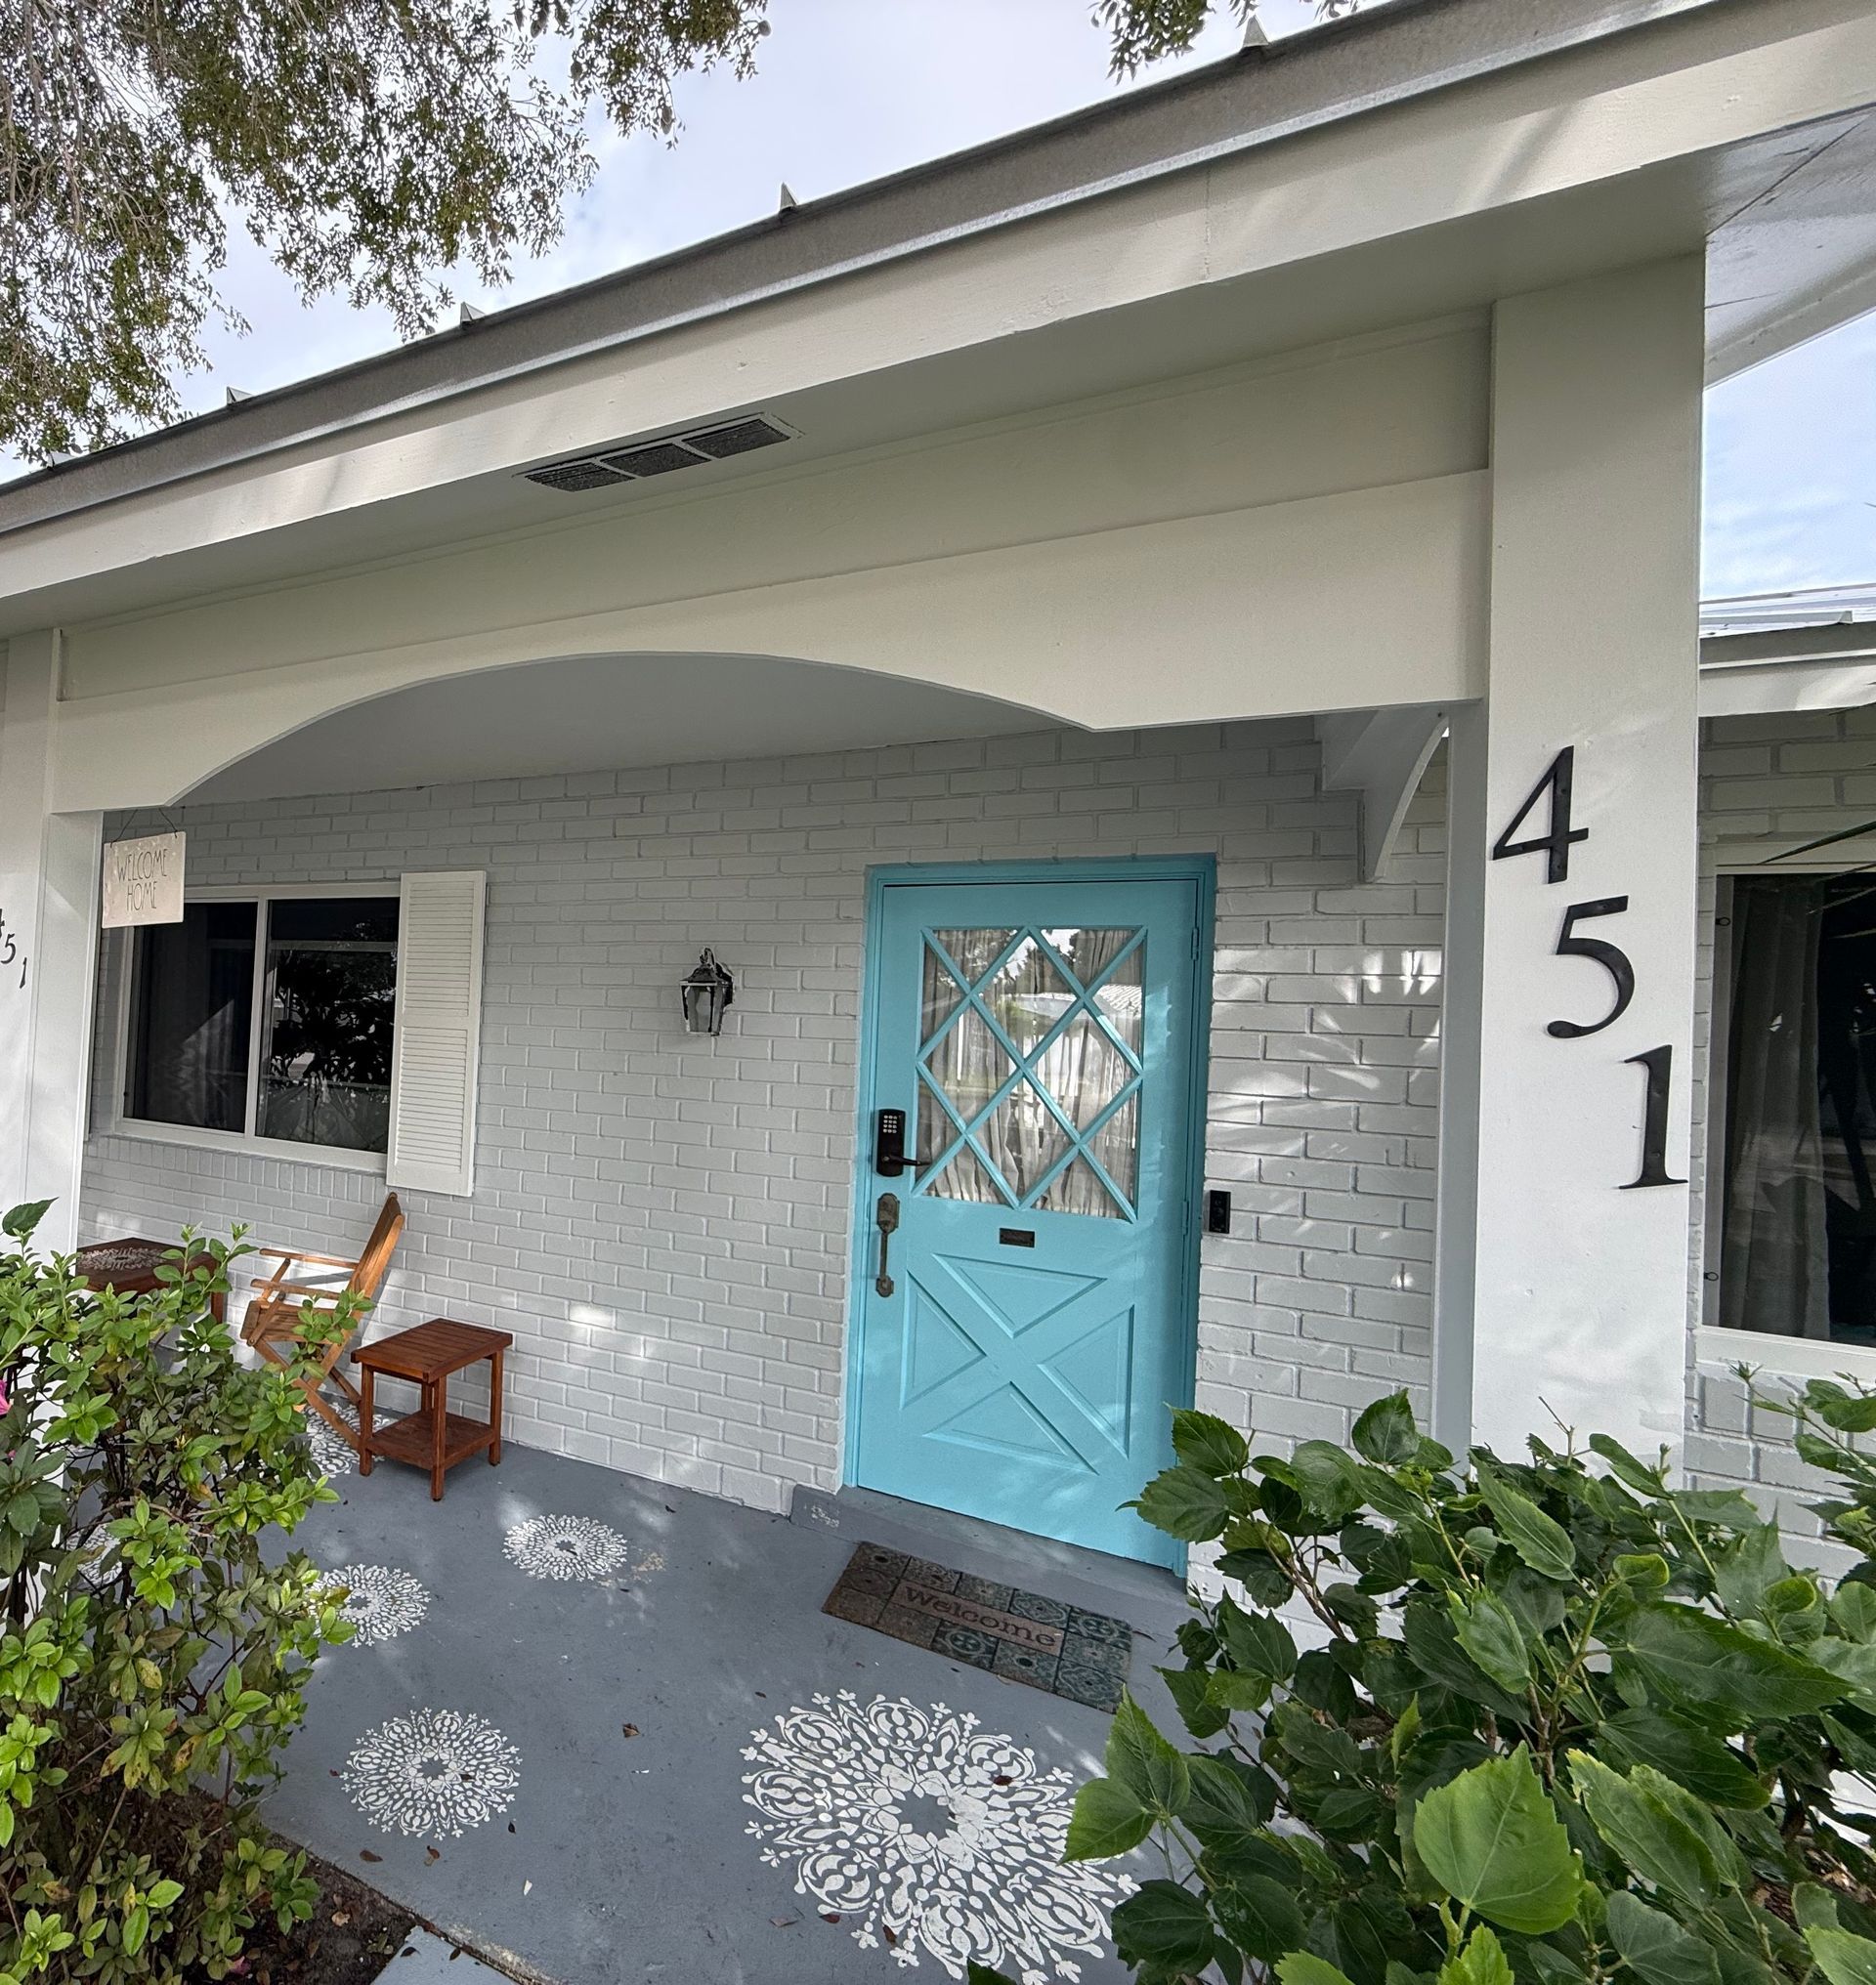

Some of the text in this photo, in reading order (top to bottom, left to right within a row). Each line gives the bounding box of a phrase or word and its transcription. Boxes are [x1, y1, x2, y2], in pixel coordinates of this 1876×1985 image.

[116, 848, 168, 882] WELCOME
[127, 881, 157, 911] HOME
[1492, 744, 1688, 1190] 451
[905, 1585, 1056, 1647] Welcome
